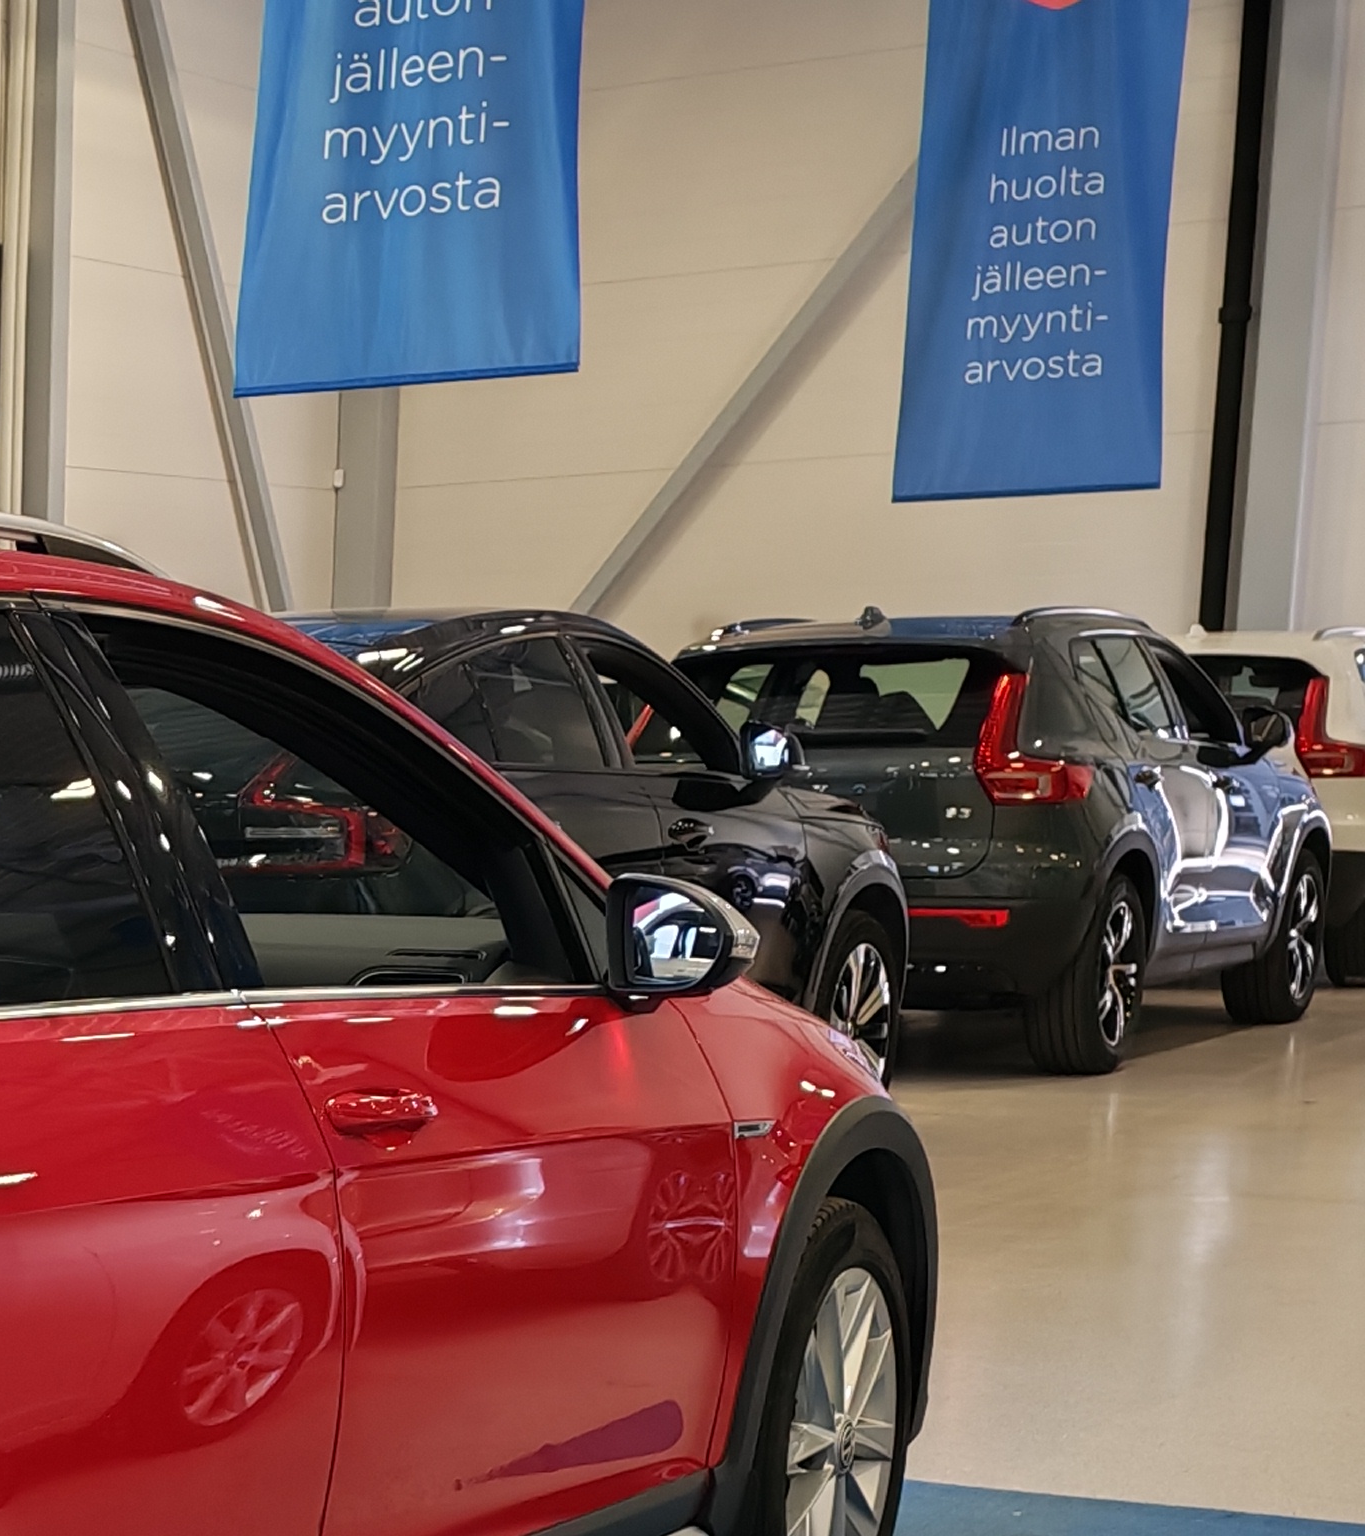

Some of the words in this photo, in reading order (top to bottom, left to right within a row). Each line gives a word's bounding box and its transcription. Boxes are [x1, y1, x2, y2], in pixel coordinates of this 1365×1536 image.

[329, 45, 507, 104] jälleen-
[323, 100, 510, 165] myynti-
[1000, 125, 1099, 157] Ilman
[321, 171, 502, 225] arvosta
[989, 165, 1105, 204] huolta
[989, 216, 1097, 249] auton
[971, 261, 1108, 302] jälleen-
[966, 301, 1109, 344] myynti-
[964, 349, 1103, 385] arvosta
